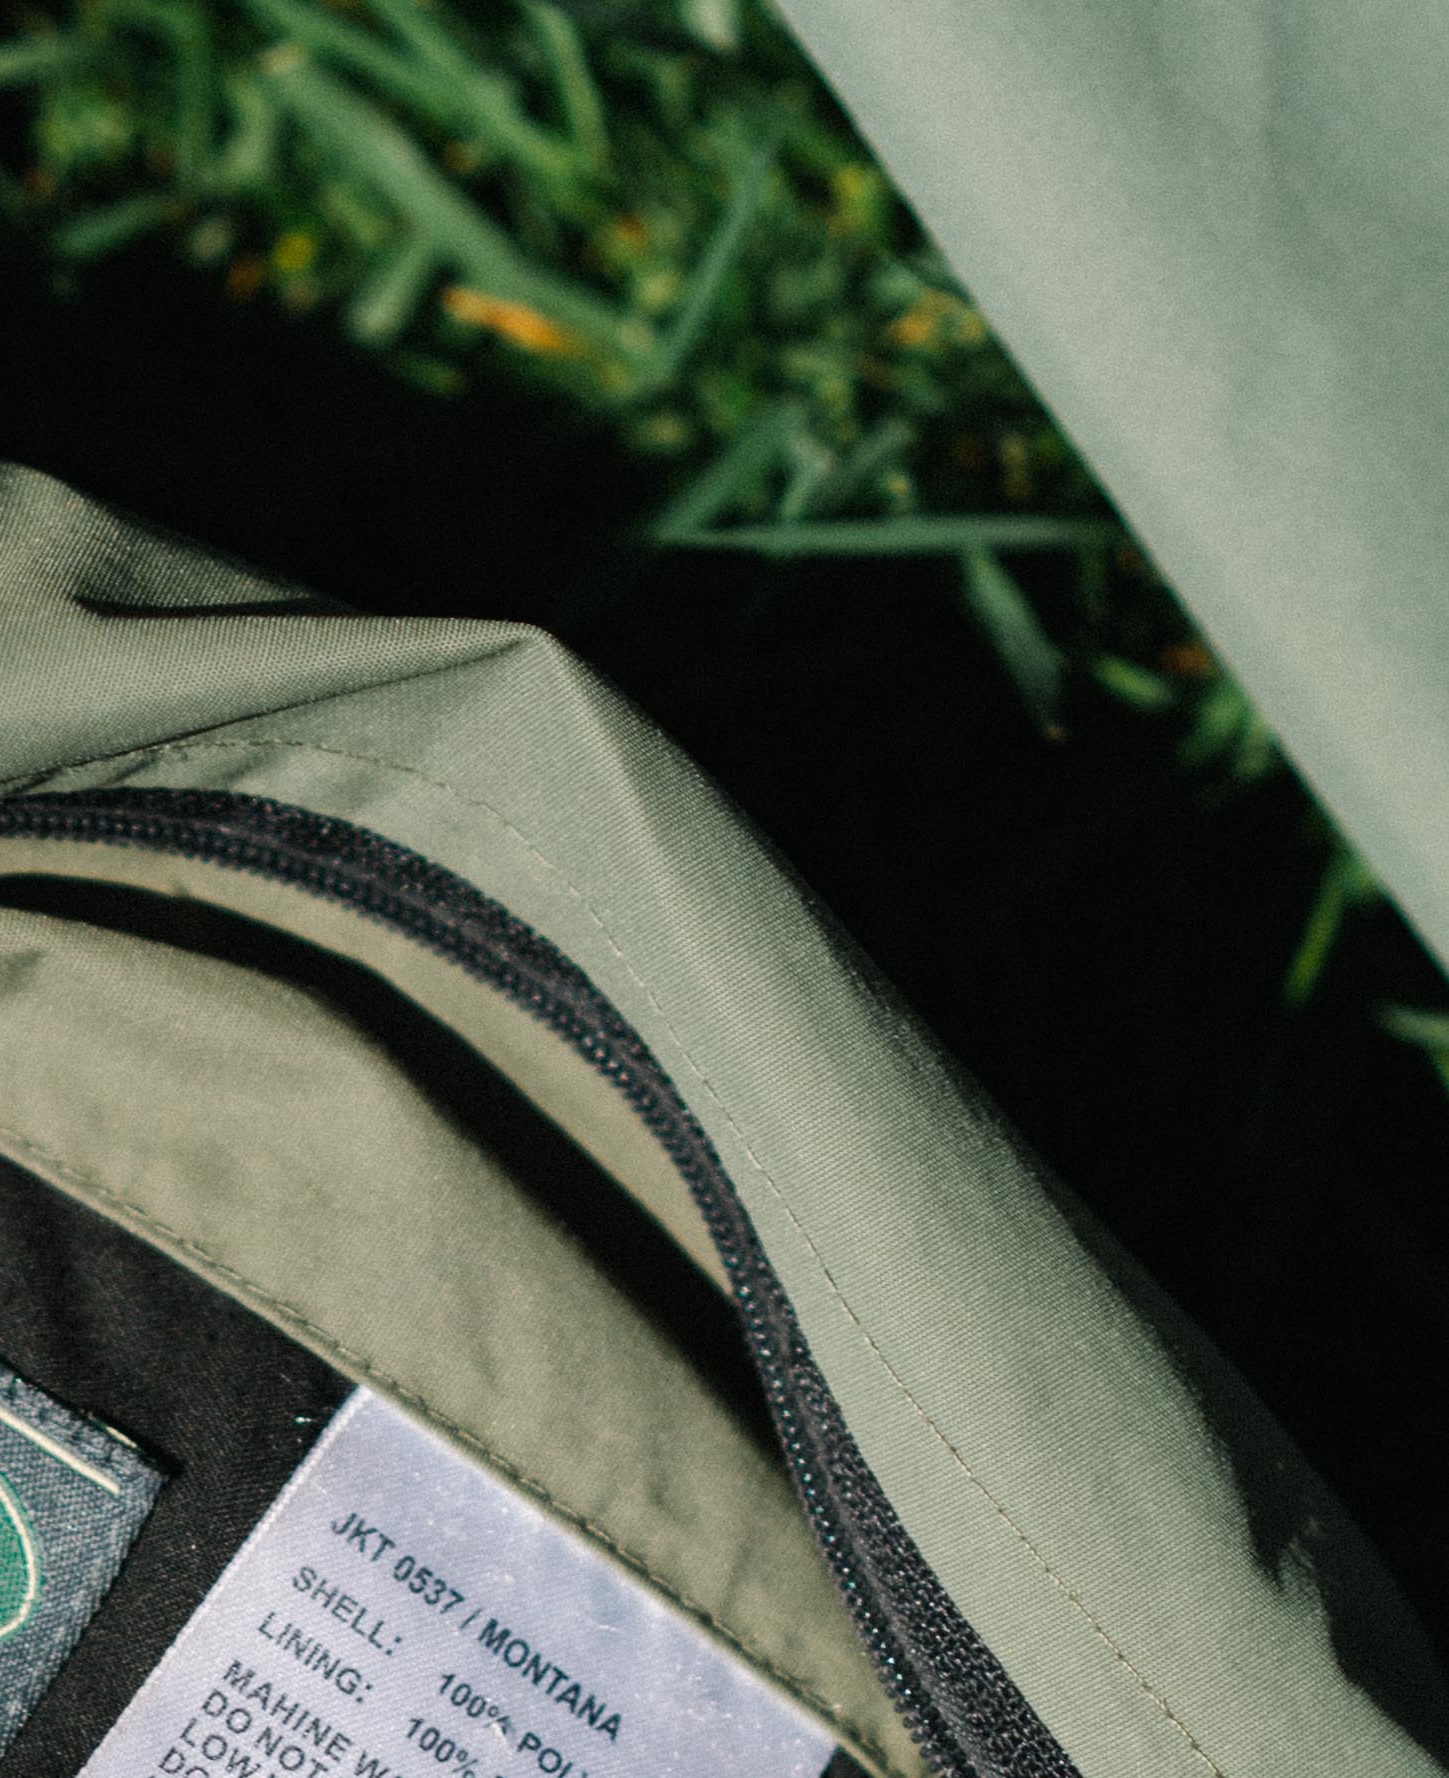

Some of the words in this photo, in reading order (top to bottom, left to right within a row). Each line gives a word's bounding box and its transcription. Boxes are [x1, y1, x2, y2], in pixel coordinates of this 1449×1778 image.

[257, 1611, 373, 1703] LINING:
[292, 1566, 403, 1656] SHELL:
[438, 1673, 512, 1735] 100%
[330, 1512, 395, 1562] JKT
[393, 1555, 466, 1615] 0537
[459, 1607, 482, 1630] /
[477, 1618, 623, 1743] MONTANA
[202, 1689, 252, 1734] DO
[223, 1659, 354, 1762] MAHINE
